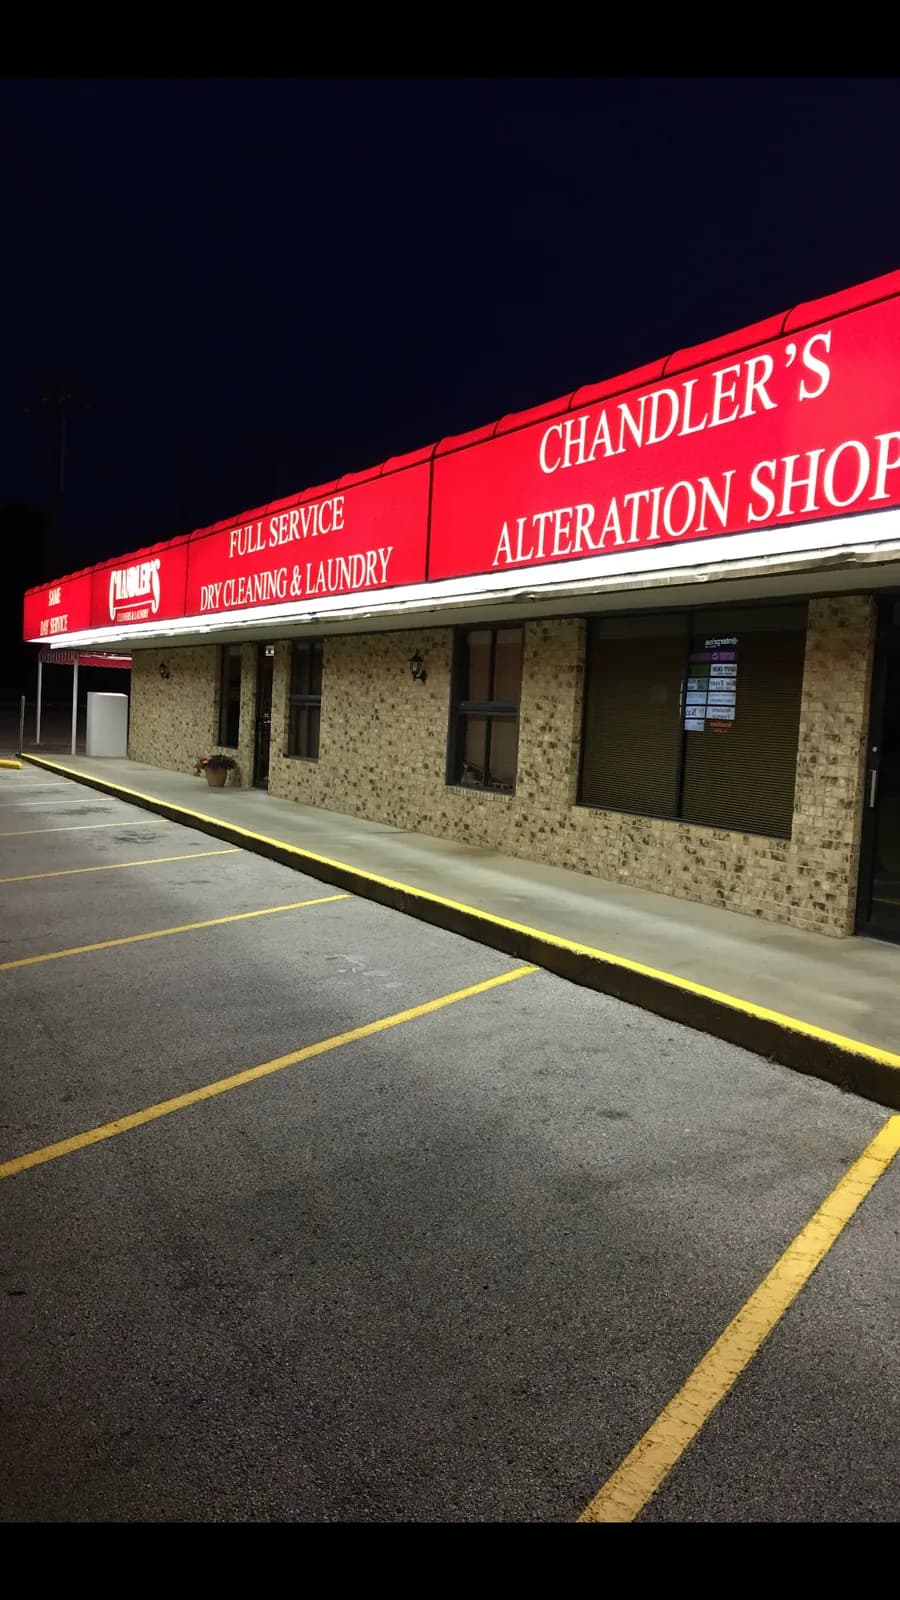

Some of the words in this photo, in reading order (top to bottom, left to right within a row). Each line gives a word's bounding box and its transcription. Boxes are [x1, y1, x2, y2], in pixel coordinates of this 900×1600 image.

[539, 330, 832, 474] CHANDLER'S
[229, 521, 267, 558] FULL
[269, 496, 345, 548] SERVICE
[492, 469, 736, 566] ALTERATION
[747, 431, 900, 523] SHOP
[200, 582, 222, 611] DRY
[223, 567, 287, 606] CLEANING
[290, 565, 301, 596] &
[305, 546, 394, 595] LAUNDRY
[50, 614, 69, 634] SERVICE
